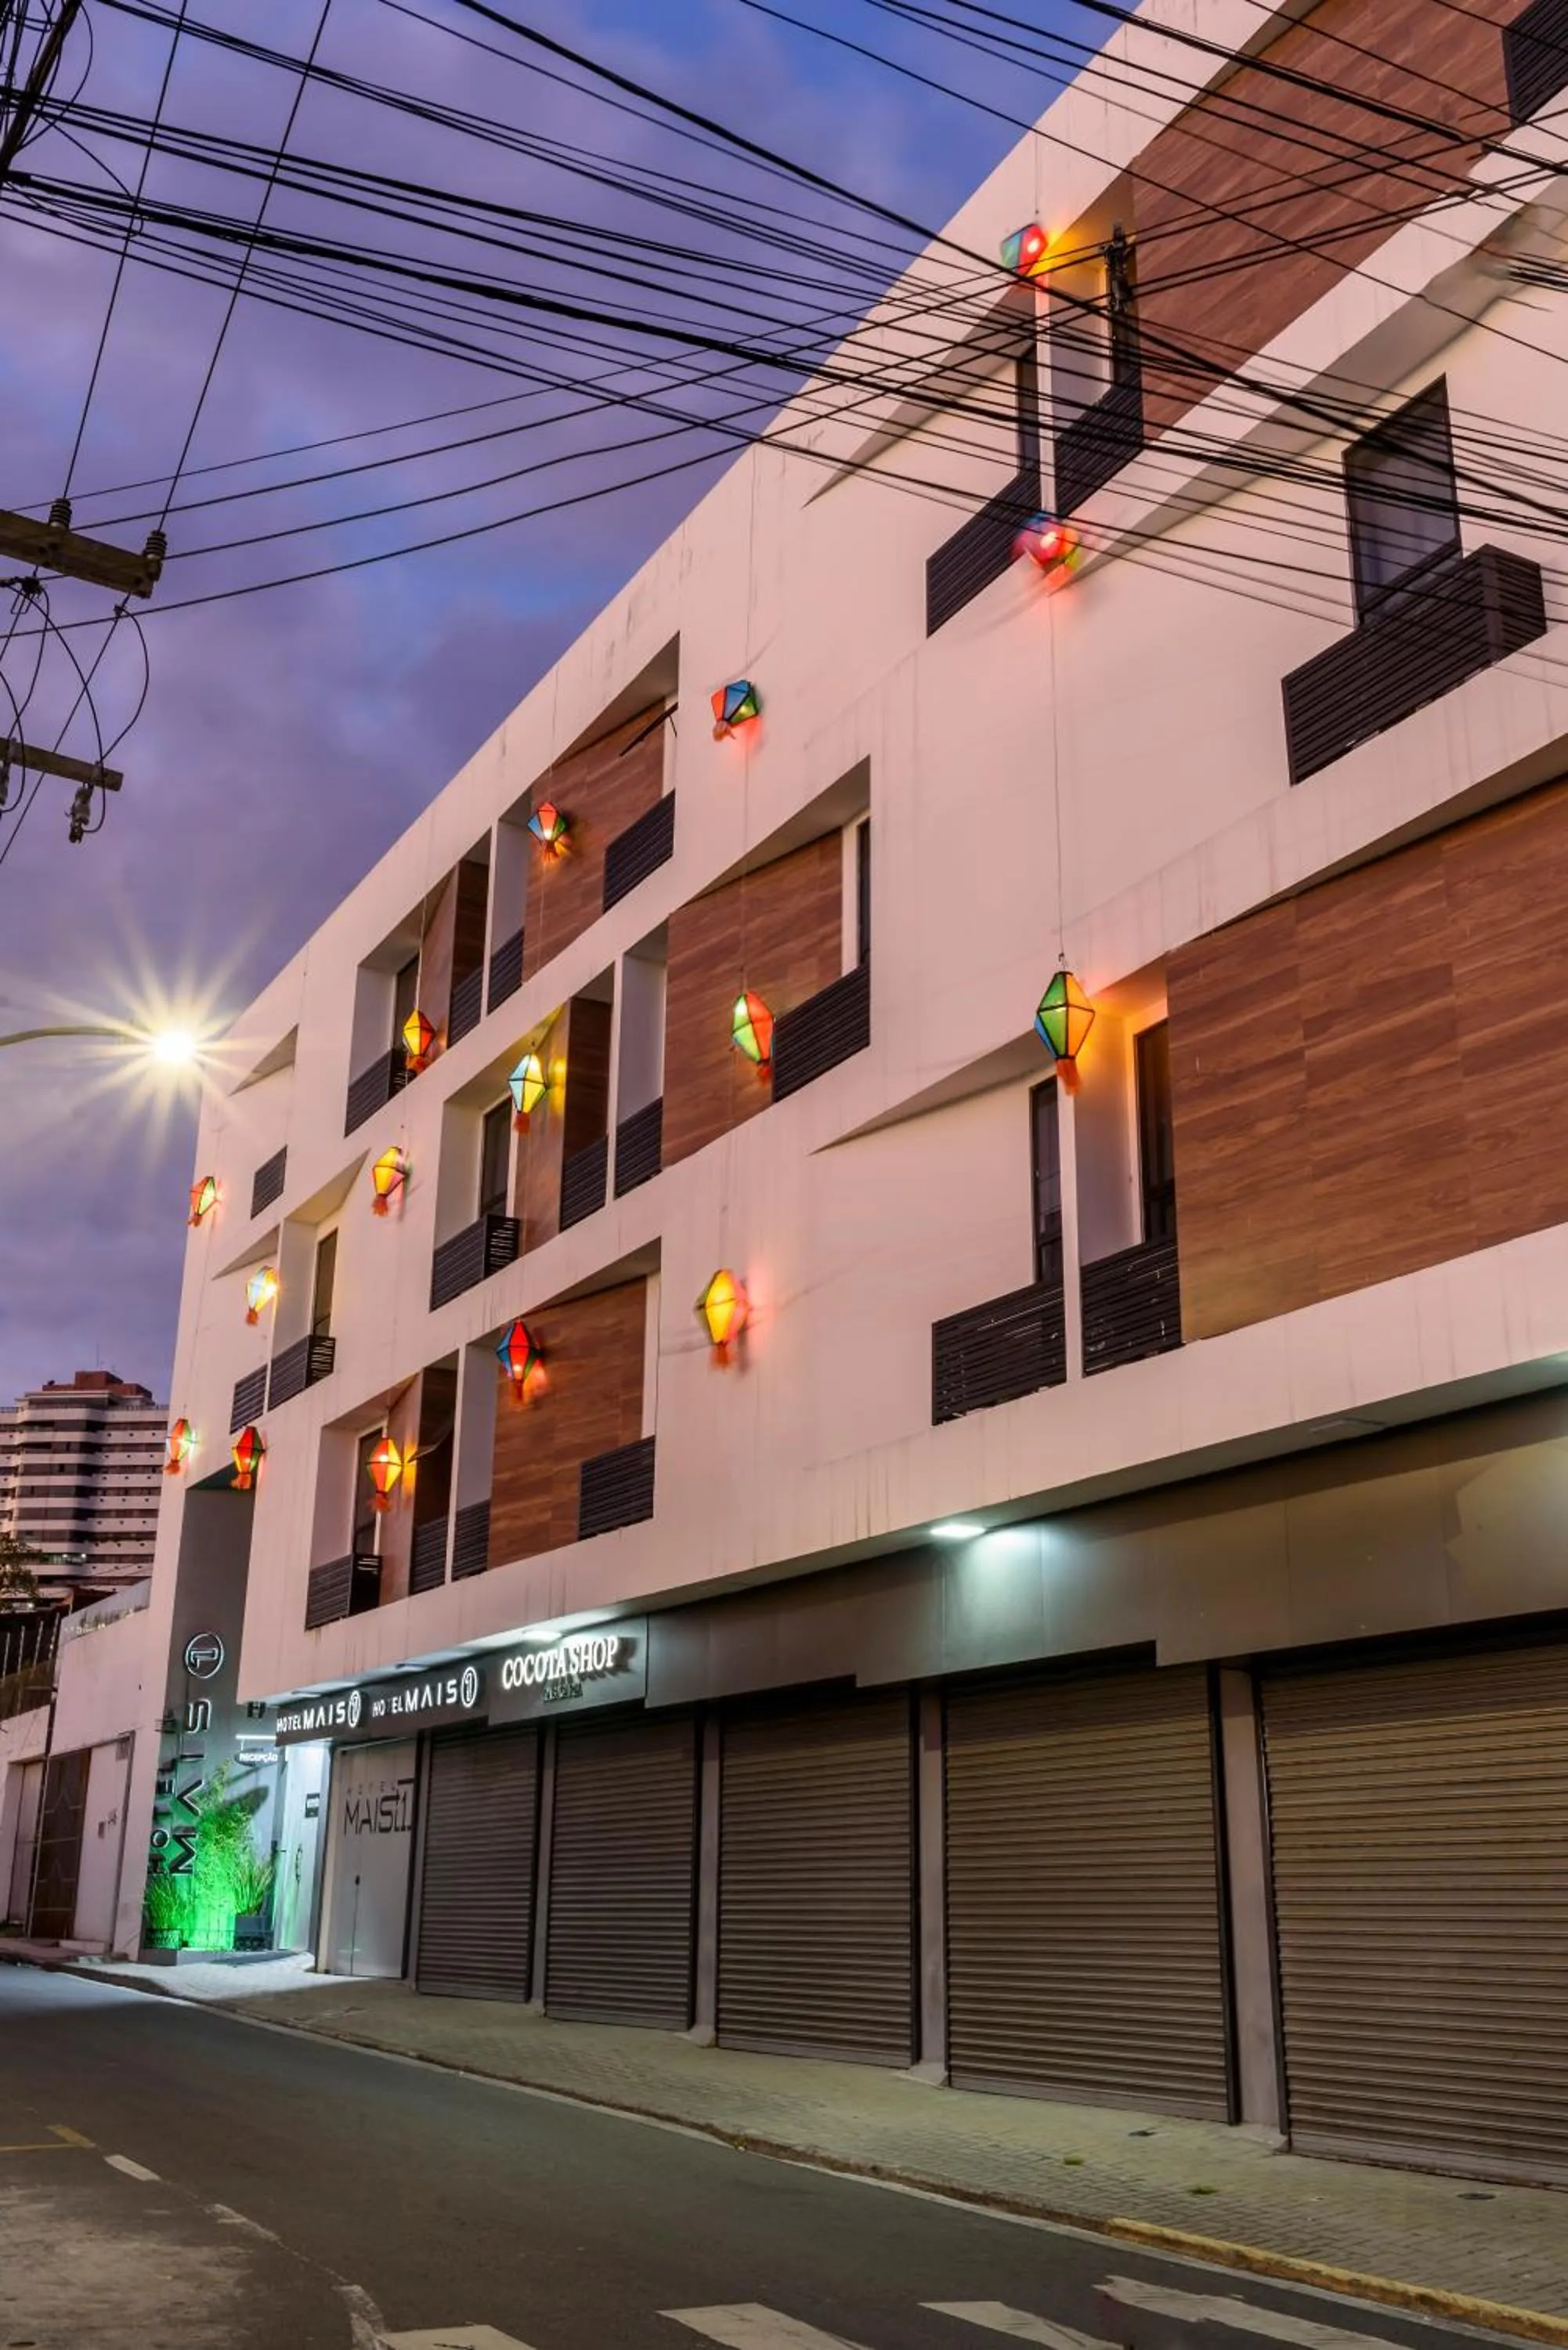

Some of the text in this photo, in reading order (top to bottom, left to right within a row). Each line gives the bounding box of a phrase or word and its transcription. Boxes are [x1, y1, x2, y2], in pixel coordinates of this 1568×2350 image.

[502, 1635, 617, 1690] COCOTA SHOP
[276, 1715, 302, 1733] HOTEL
